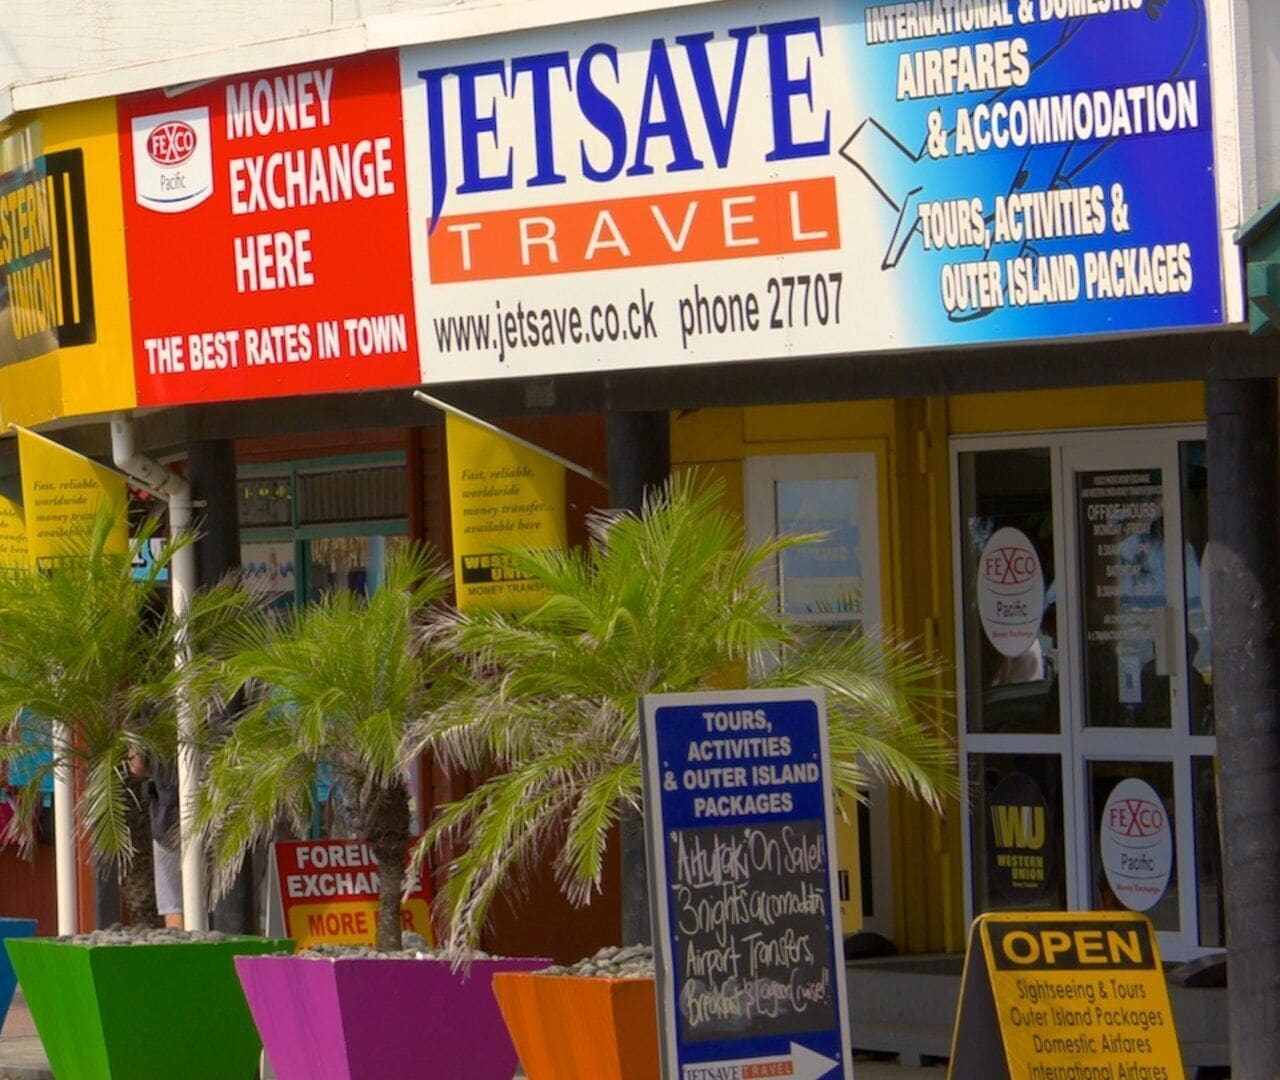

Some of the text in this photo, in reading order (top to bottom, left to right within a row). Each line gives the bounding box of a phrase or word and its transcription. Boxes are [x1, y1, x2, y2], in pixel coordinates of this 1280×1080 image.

[896, 38, 1031, 101] AIRFARES
[225, 68, 334, 140] MONEY
[417, 17, 832, 237] JETSAVE
[926, 80, 1198, 159] & ACCOMMODATION
[150, 123, 194, 163] FEXCO
[159, 170, 187, 193] Pacific
[228, 137, 395, 215] EXCHANGE
[918, 183, 1129, 251] TOURS, ACTIVITIES &
[447, 190, 828, 272] TRAVEL
[234, 229, 314, 293] HERE
[941, 242, 1192, 311] OUTER ISLAND PACKAGES
[433, 272, 844, 363] www.jetsave.co.ck phone 27707
[144, 313, 408, 375] THE BEST RATES IN TOWN
[461, 469, 487, 481] Fast,
[34, 495, 89, 506] worldwide
[462, 487, 521, 499] worldwide
[36, 513, 68, 524] money
[463, 505, 499, 518] money
[1088, 503, 1156, 521] OFFICE HOURS
[464, 519, 542, 534] available here
[985, 548, 1036, 585] FEXCO
[703, 710, 773, 734] TOURS,
[687, 737, 792, 762] ACTIVITIES
[663, 762, 819, 791] & OUTER ISLAND
[694, 793, 794, 818] PACKAGES
[1109, 799, 1164, 836] FEXCO
[996, 854, 1044, 868] WESTERN
[1011, 867, 1044, 881] UNION
[1121, 853, 1154, 872] Pacific
[308, 911, 368, 937] MORE
[686, 935, 742, 985] Airport
[1002, 930, 1143, 965] OPEN
[1016, 979, 1146, 1004] Sightseeing & Tours
[1010, 1005, 1165, 1031] Outer Island Packages
[1033, 1033, 1152, 1054] Domestic Airfares
[742, 1062, 793, 1076] TRAVEL
[1028, 1060, 1168, 1080] International Airfares
